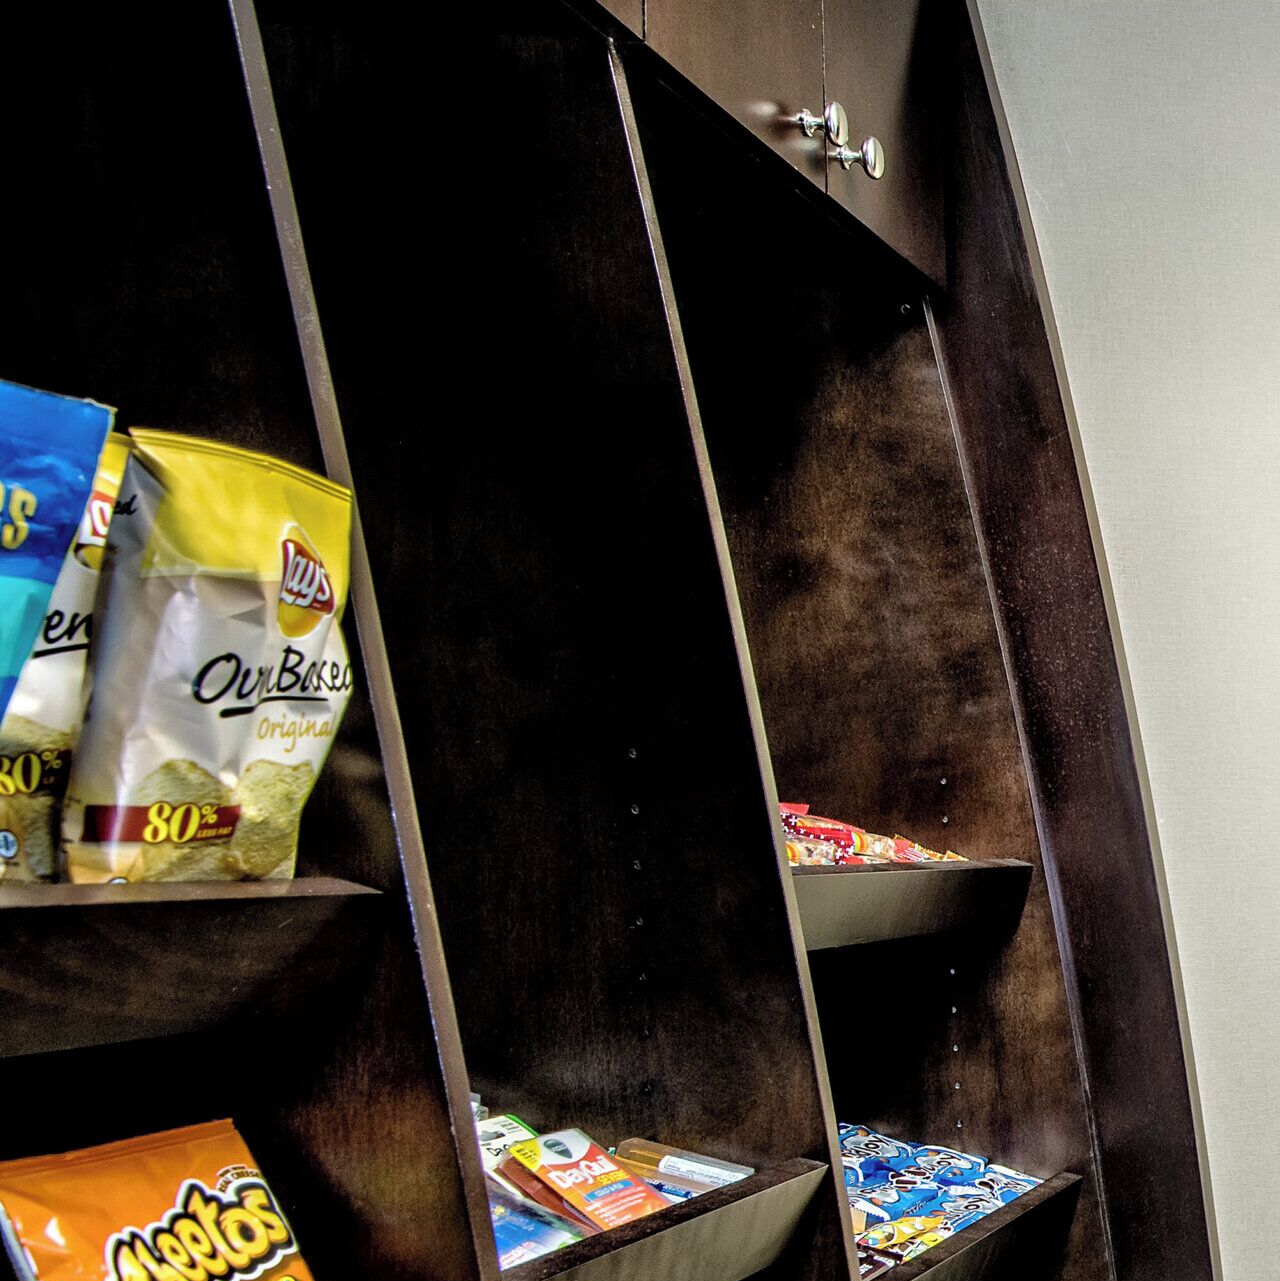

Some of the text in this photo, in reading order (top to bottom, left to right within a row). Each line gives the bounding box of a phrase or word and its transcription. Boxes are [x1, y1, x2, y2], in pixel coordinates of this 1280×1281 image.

[281, 540, 331, 607] Lay's
[258, 710, 338, 754] Original
[143, 801, 219, 844] 80%
